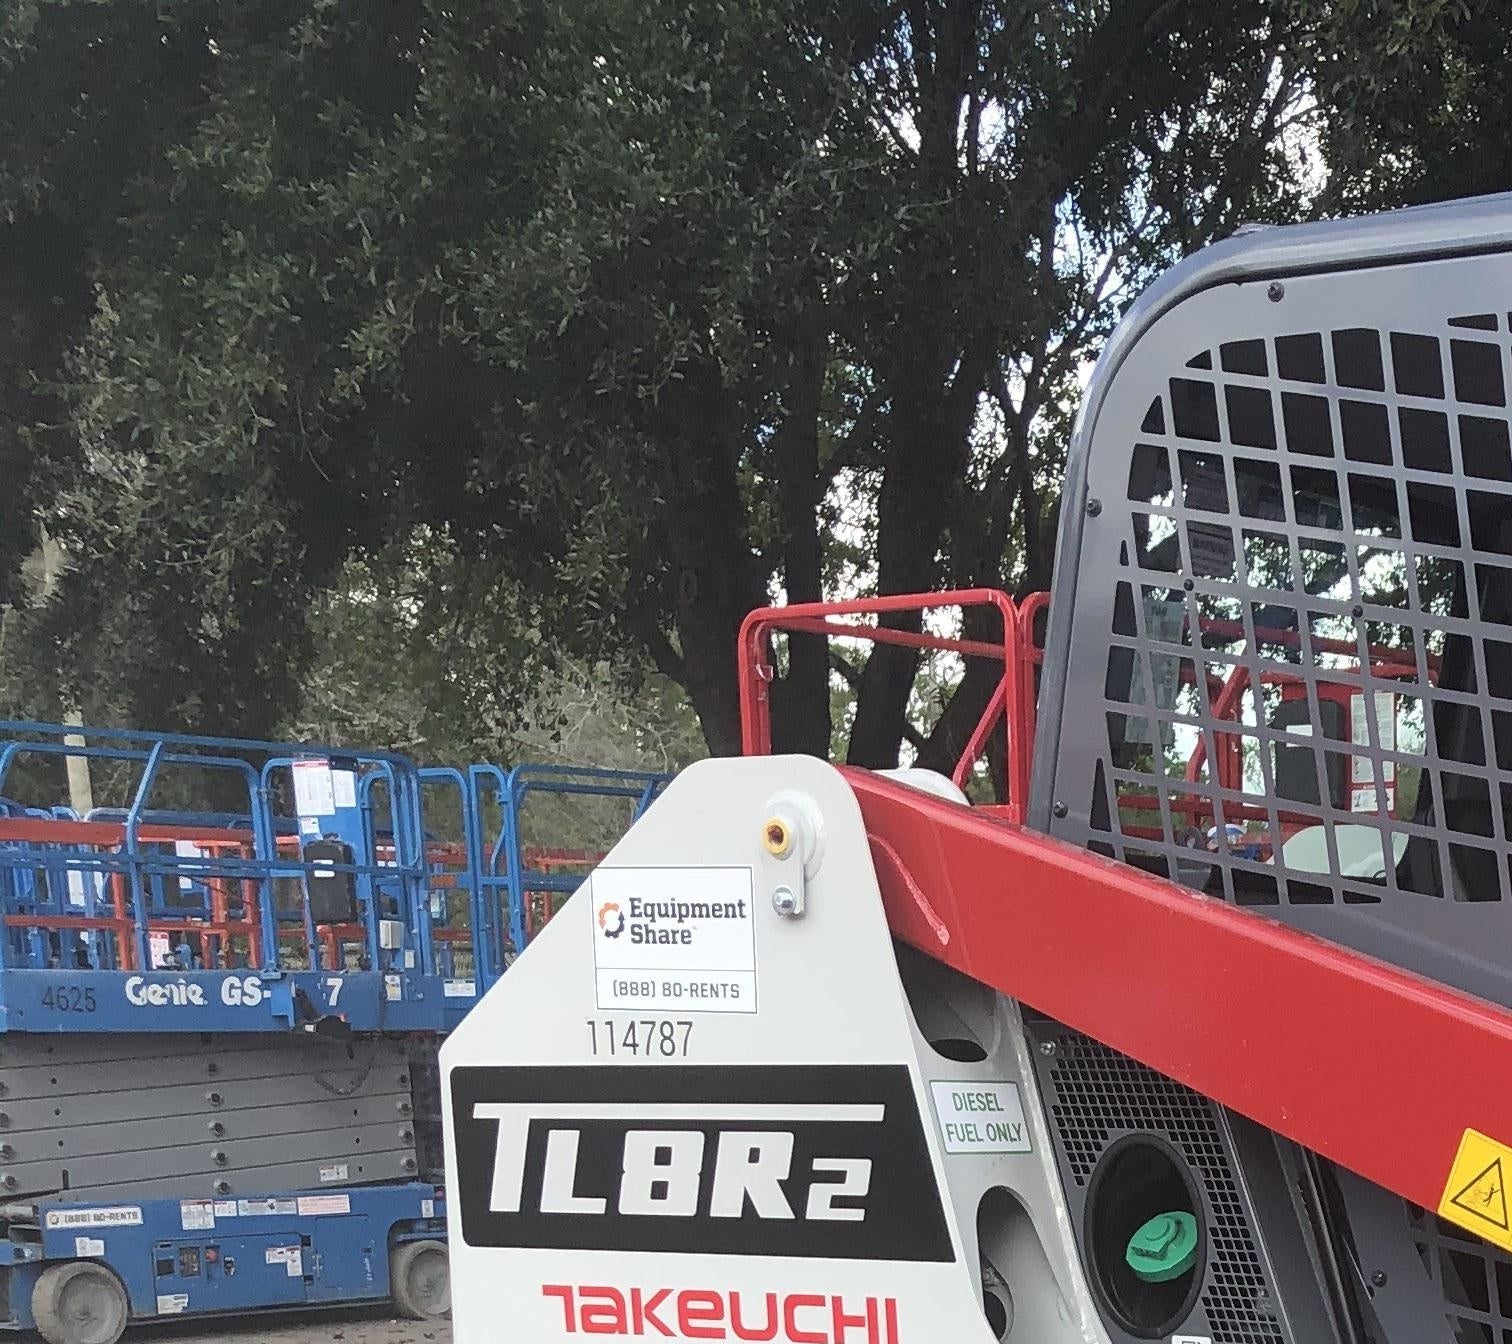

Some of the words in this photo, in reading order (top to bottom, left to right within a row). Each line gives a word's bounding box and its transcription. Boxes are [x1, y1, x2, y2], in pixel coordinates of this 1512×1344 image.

[628, 897, 747, 924] Equipment
[630, 923, 693, 945] Share
[40, 985, 97, 1013] 4625
[125, 975, 208, 1007] Genie
[612, 979, 656, 998] (888)
[662, 981, 740, 999] 80-RENTS
[586, 1019, 693, 1057] 114787
[951, 1092, 1005, 1112] DIESEL
[945, 1122, 985, 1143] FUEL
[985, 1122, 1022, 1143] ONLY
